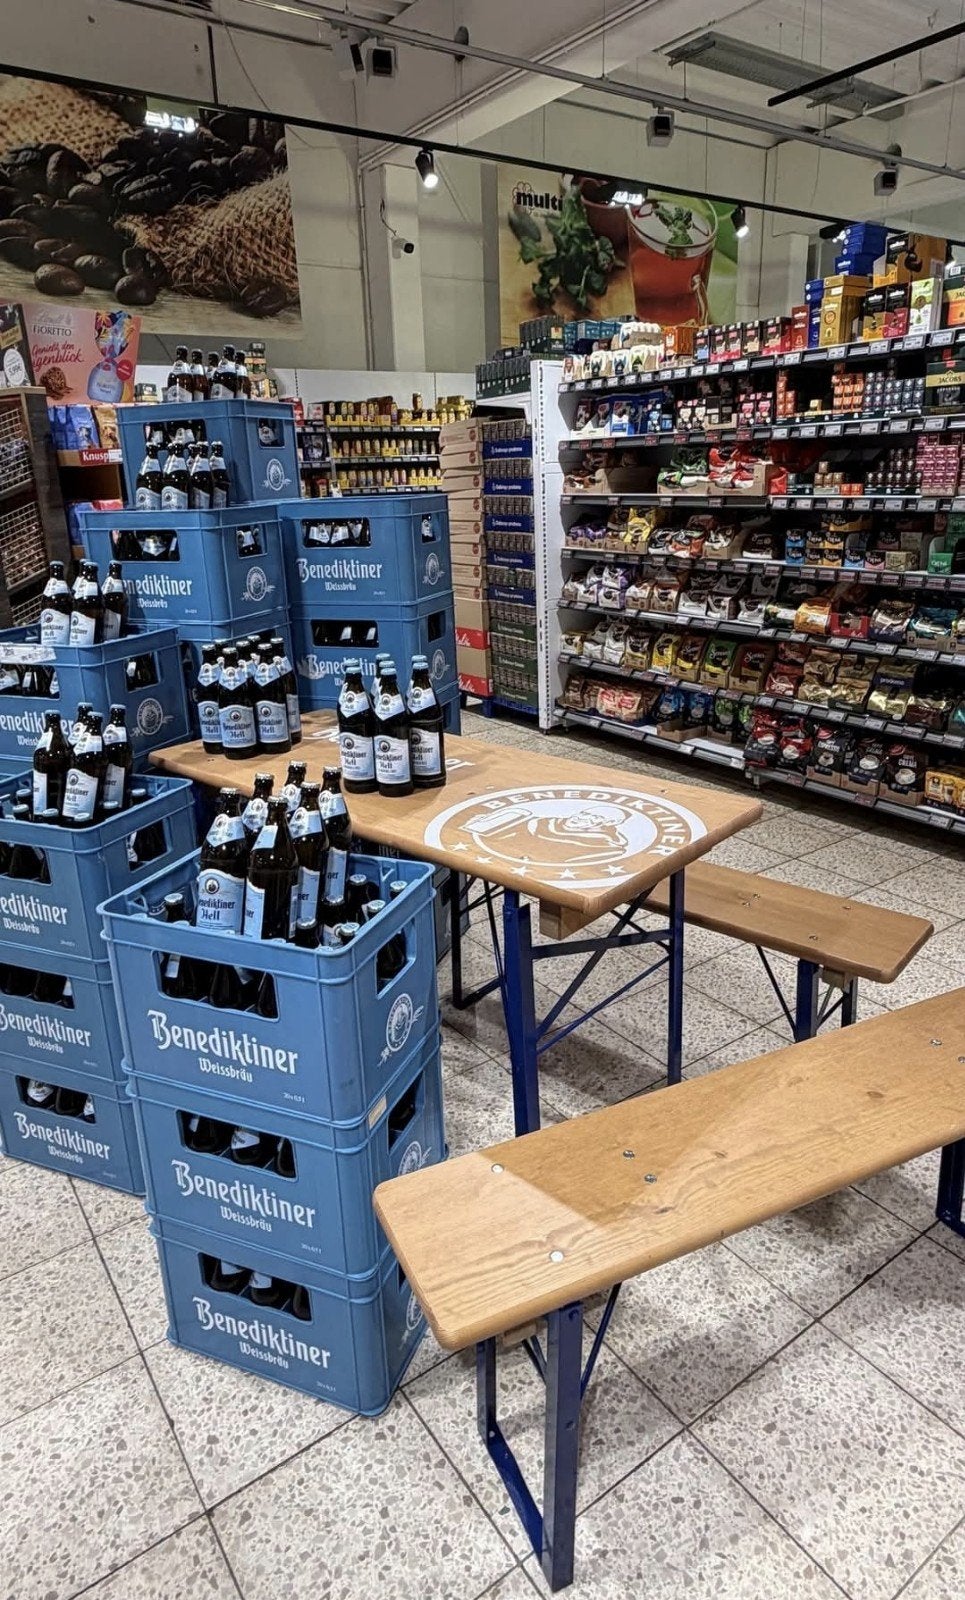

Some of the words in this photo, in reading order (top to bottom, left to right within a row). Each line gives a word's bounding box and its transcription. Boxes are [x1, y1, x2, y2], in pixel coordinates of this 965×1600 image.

[82, 450, 109, 463] Knusp
[296, 557, 382, 583] Benediktiner
[122, 574, 193, 597] enediktiner
[229, 730, 245, 739] Hell
[481, 789, 687, 857] BENEDIKTINER
[0, 893, 67, 925] ediktiner
[198, 898, 236, 910] enediktiner
[200, 907, 220, 921] Hell
[147, 1009, 298, 1075] Benediktiner
[198, 1057, 253, 1083] Weissbräu
[13, 1111, 110, 1160] Benediktiner
[171, 1159, 316, 1228] Benediktiner
[219, 1205, 273, 1232] Weissbräu
[192, 1296, 331, 1369] Benediktiner
[239, 1341, 289, 1369] Weissbräu
